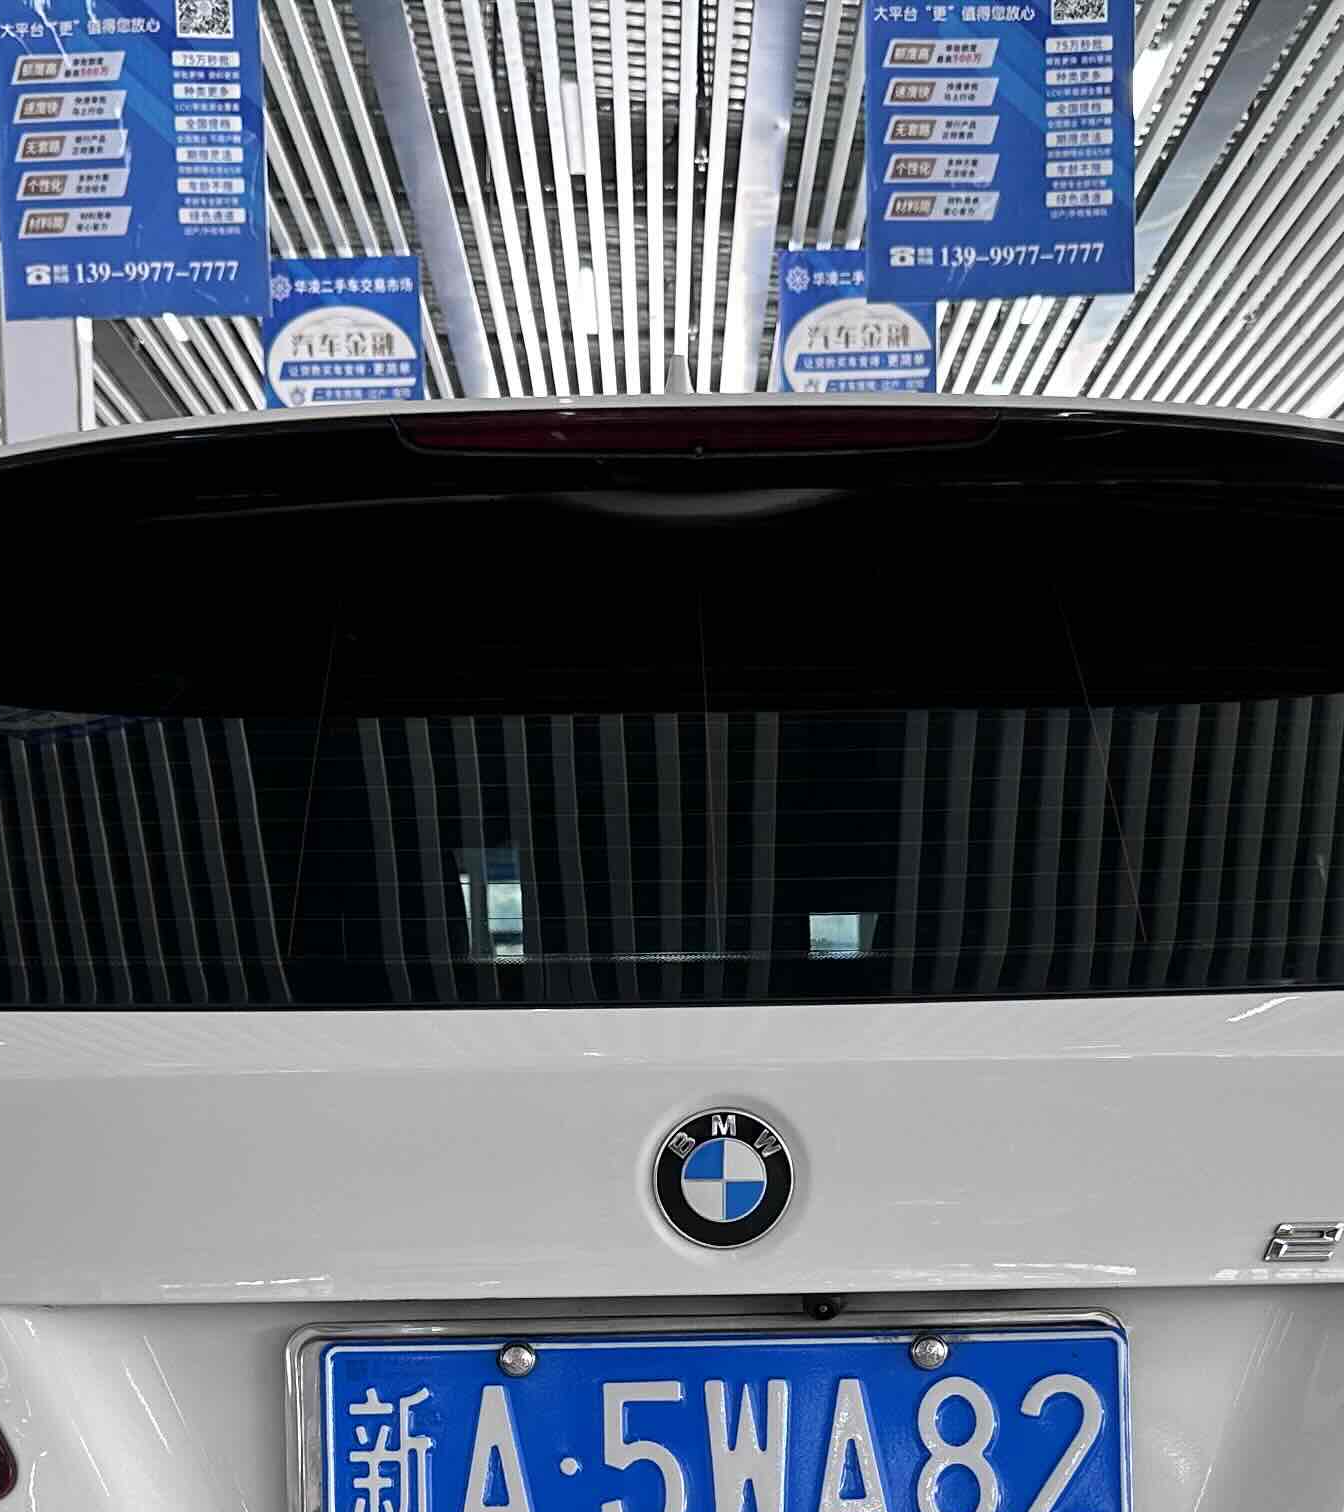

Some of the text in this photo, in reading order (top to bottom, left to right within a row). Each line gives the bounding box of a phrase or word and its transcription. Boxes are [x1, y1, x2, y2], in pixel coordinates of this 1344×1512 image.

[896, 161, 931, 177] 个性化
[27, 179, 64, 193] 个性化
[939, 243, 1104, 267] 139-9977-7777
[74, 260, 239, 285] 139-9977-7777
[294, 276, 414, 294] 华凌二手车交易市场
[291, 332, 394, 358] 汽车金融
[808, 323, 910, 350] 汽车金融
[668, 1115, 782, 1159] BMW
